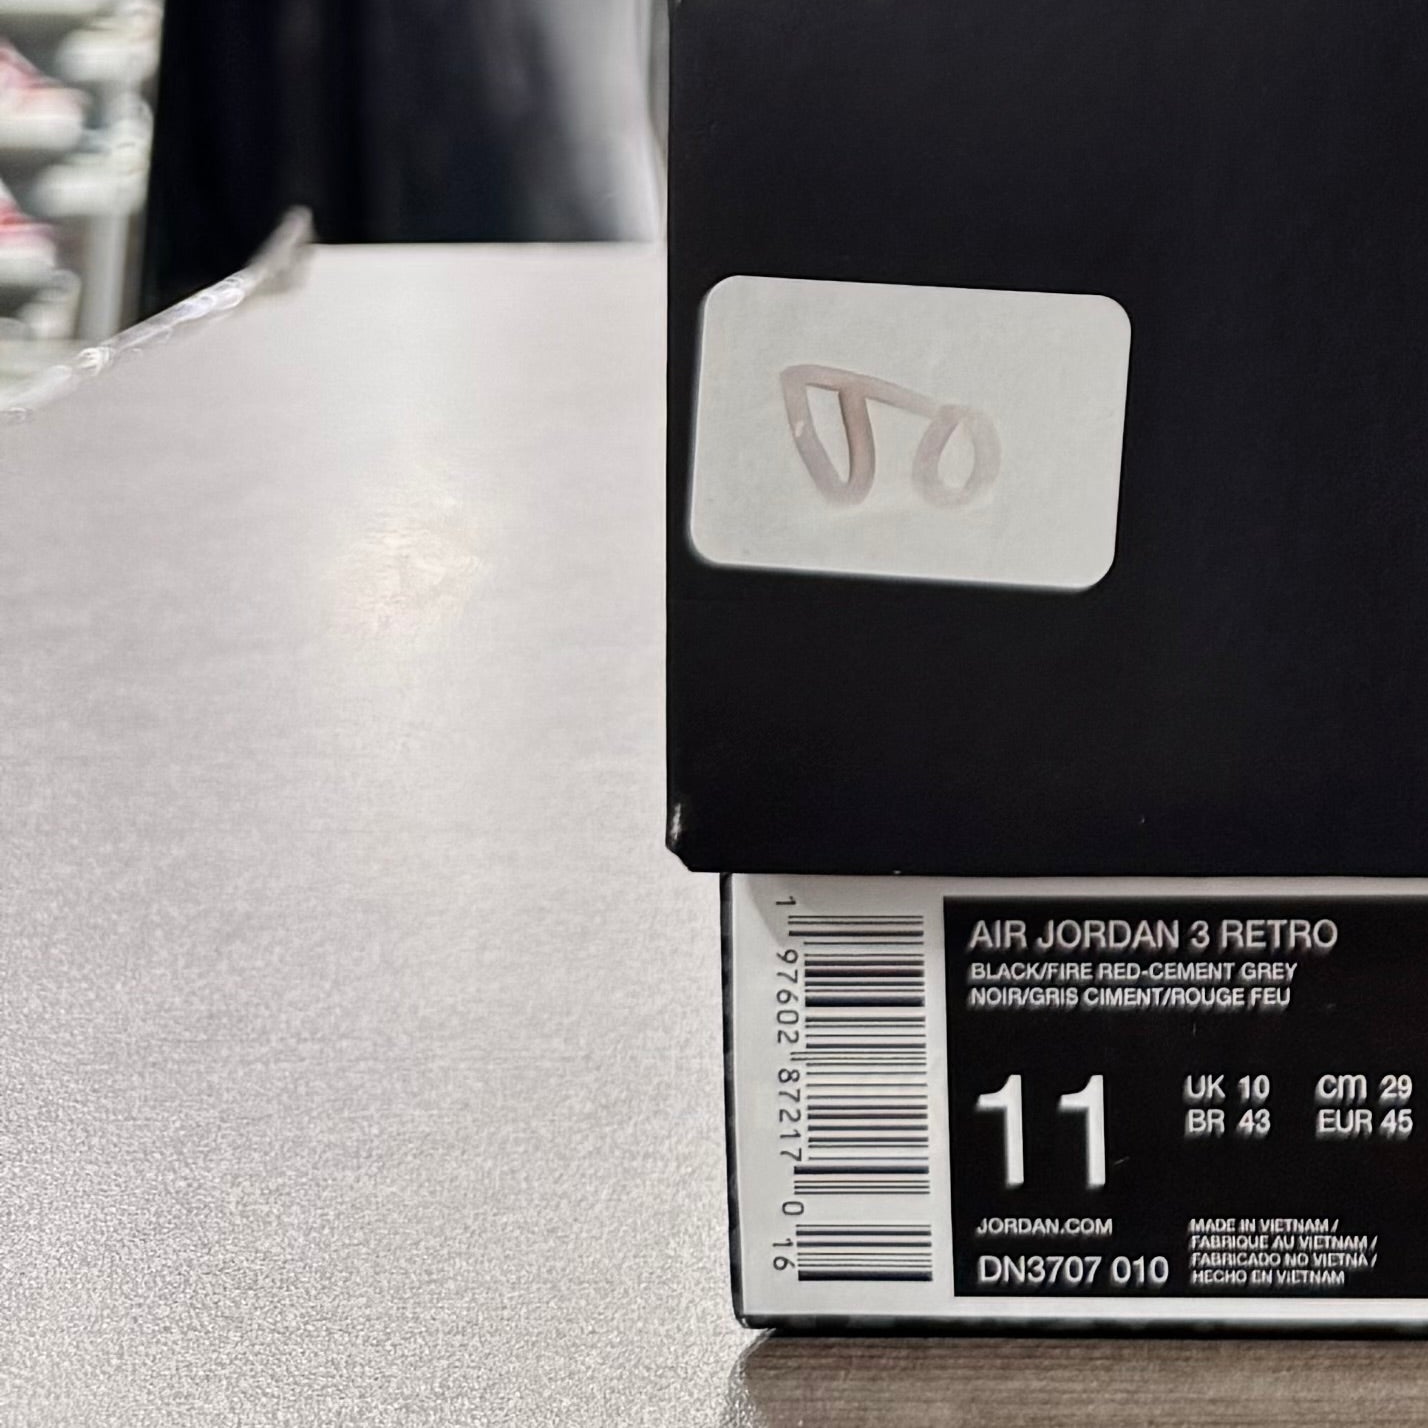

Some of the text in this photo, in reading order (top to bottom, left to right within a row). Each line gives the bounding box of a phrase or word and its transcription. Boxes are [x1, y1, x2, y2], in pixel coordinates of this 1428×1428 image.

[970, 919, 1338, 949] AIR JORDAN 3 RETRO
[970, 962, 1298, 982] BLACK/FIRE RED-CEMENT GREY
[776, 948, 800, 1044] 97602
[969, 987, 1291, 1009] NOIR/GRIS CIMENT/ROUGE FEU
[1185, 1075, 1226, 1100] UK
[1238, 1075, 1270, 1101] 10
[1380, 1075, 1413, 1101] 29
[778, 1067, 802, 1162] 87217
[1186, 1109, 1414, 1136] BR 43 EUR 45
[976, 1074, 1106, 1188] 11
[976, 1217, 1113, 1235] JORDAN.COM
[1189, 1218, 1236, 1233] MADE
[1240, 1218, 1256, 1233] IN
[1260, 1218, 1329, 1234] VIETNAM
[773, 1238, 796, 1271] 16
[1272, 1235, 1295, 1250] AU
[1299, 1235, 1368, 1250] VIETNAM
[978, 1255, 1169, 1285] DN3707 010
[1190, 1252, 1281, 1267] FABRICADO
[1284, 1252, 1309, 1267] NO
[1192, 1269, 1346, 1285] HECHO EN VIETNAM
